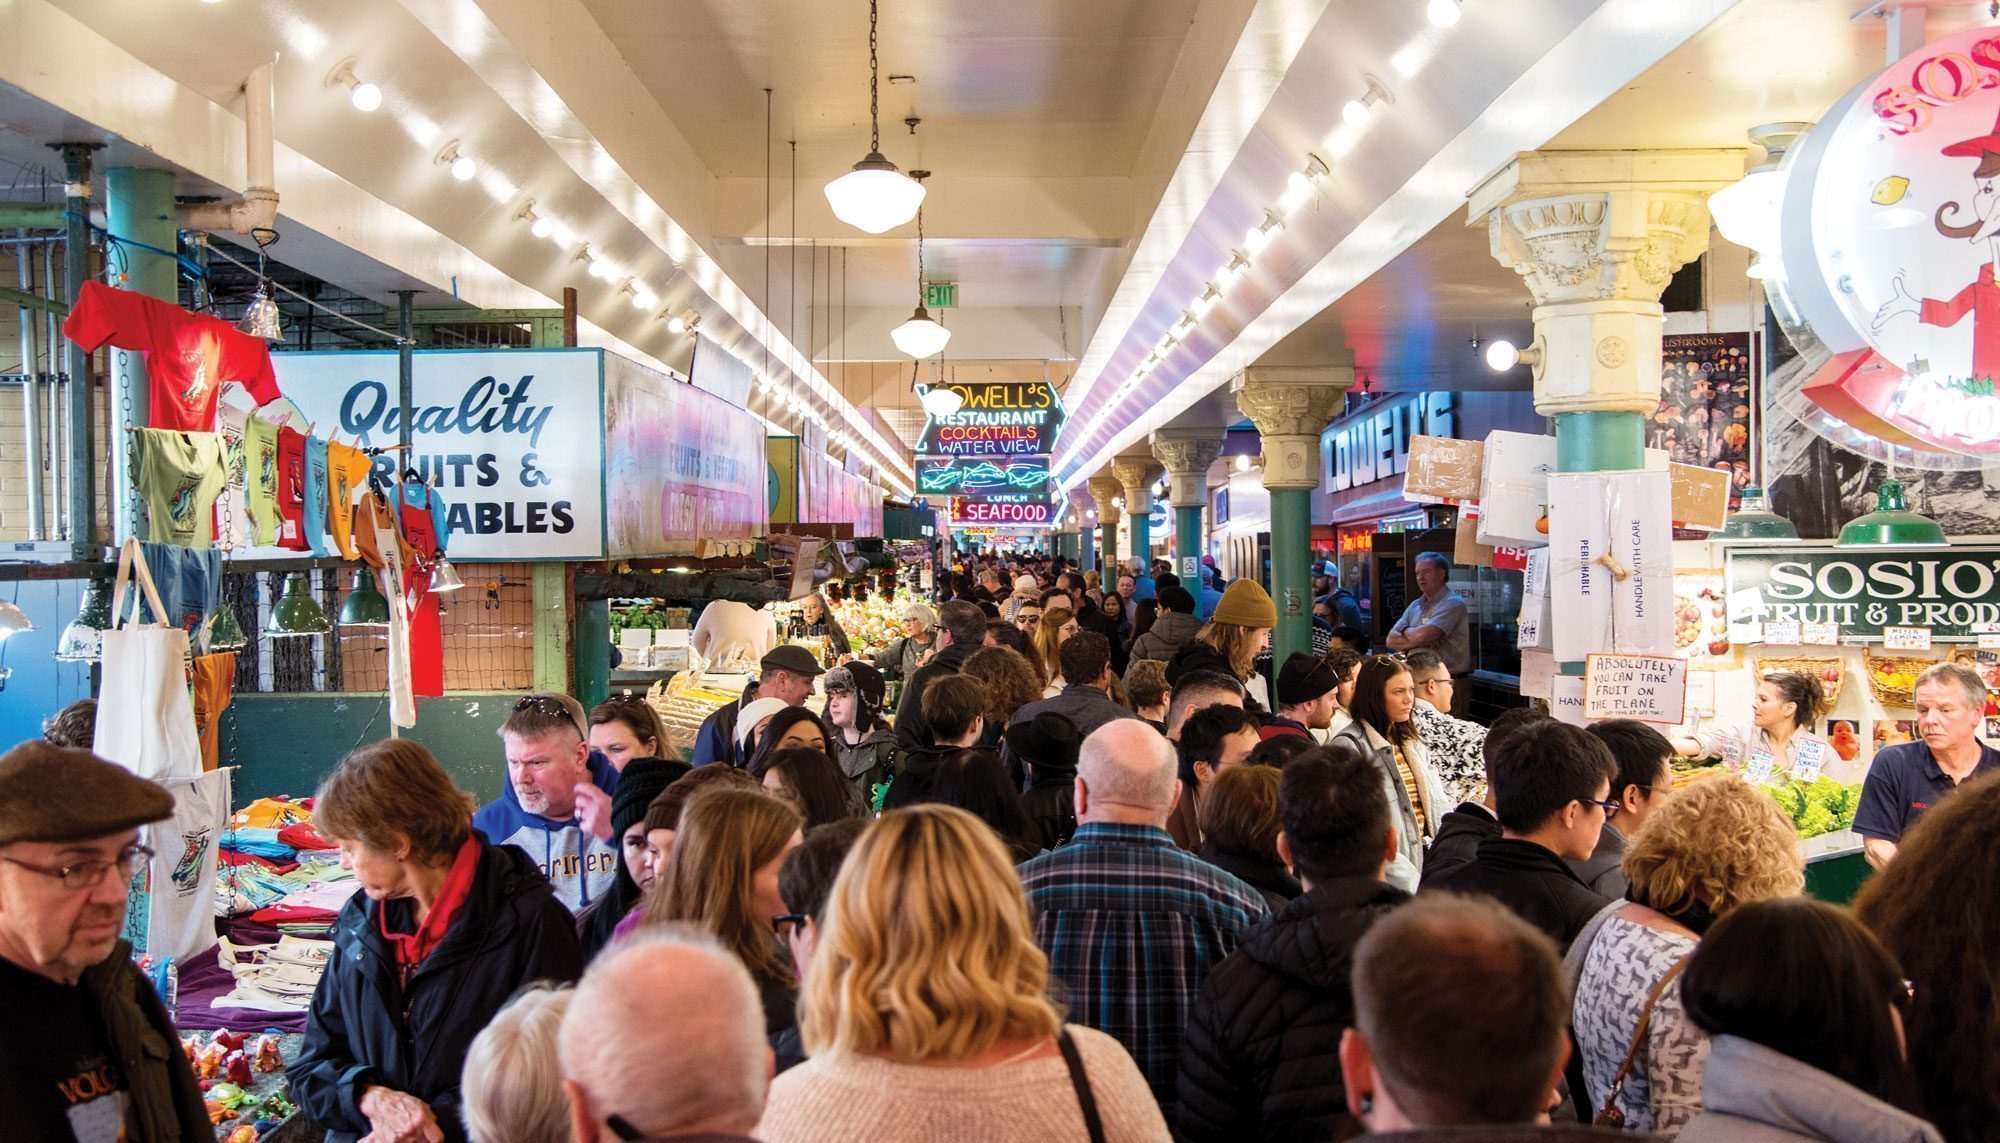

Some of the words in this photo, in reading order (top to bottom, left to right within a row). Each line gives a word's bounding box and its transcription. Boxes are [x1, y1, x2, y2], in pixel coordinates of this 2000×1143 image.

[927, 285, 954, 306] EXIT
[1662, 336, 1725, 348] USHROOMS
[950, 383, 1051, 409] OWELL'S
[339, 375, 554, 449] Quality
[934, 410, 1048, 426] RESTAURANT
[940, 426, 1037, 440] COCKTAILS
[938, 440, 999, 454] WATER
[1001, 439, 1041, 453] VIEW
[369, 453, 499, 488] RITS
[519, 452, 551, 488] &
[986, 494, 1028, 503] LUNCH
[966, 503, 1047, 521] SEAFOOD
[1631, 519, 1641, 546] CARE
[1634, 577, 1644, 618] HANDLE
[1749, 602, 1858, 626] FRUIT
[1864, 602, 1889, 626] &
[1898, 602, 2000, 626] PROD
[1891, 628, 1919, 636] MEYER
[1596, 657, 1677, 676] ABSOLUTELY
[1594, 674, 1610, 685] YOU
[1612, 672, 1633, 682] CAN
[1640, 673, 1667, 683] TAKE
[1596, 685, 1629, 695] FRUIT
[1637, 687, 1654, 695] ON
[1559, 697, 1584, 706] HAN
[1591, 700, 1607, 710] THE
[1613, 698, 1656, 709] PLANE
[537, 851, 618, 879] ariner
